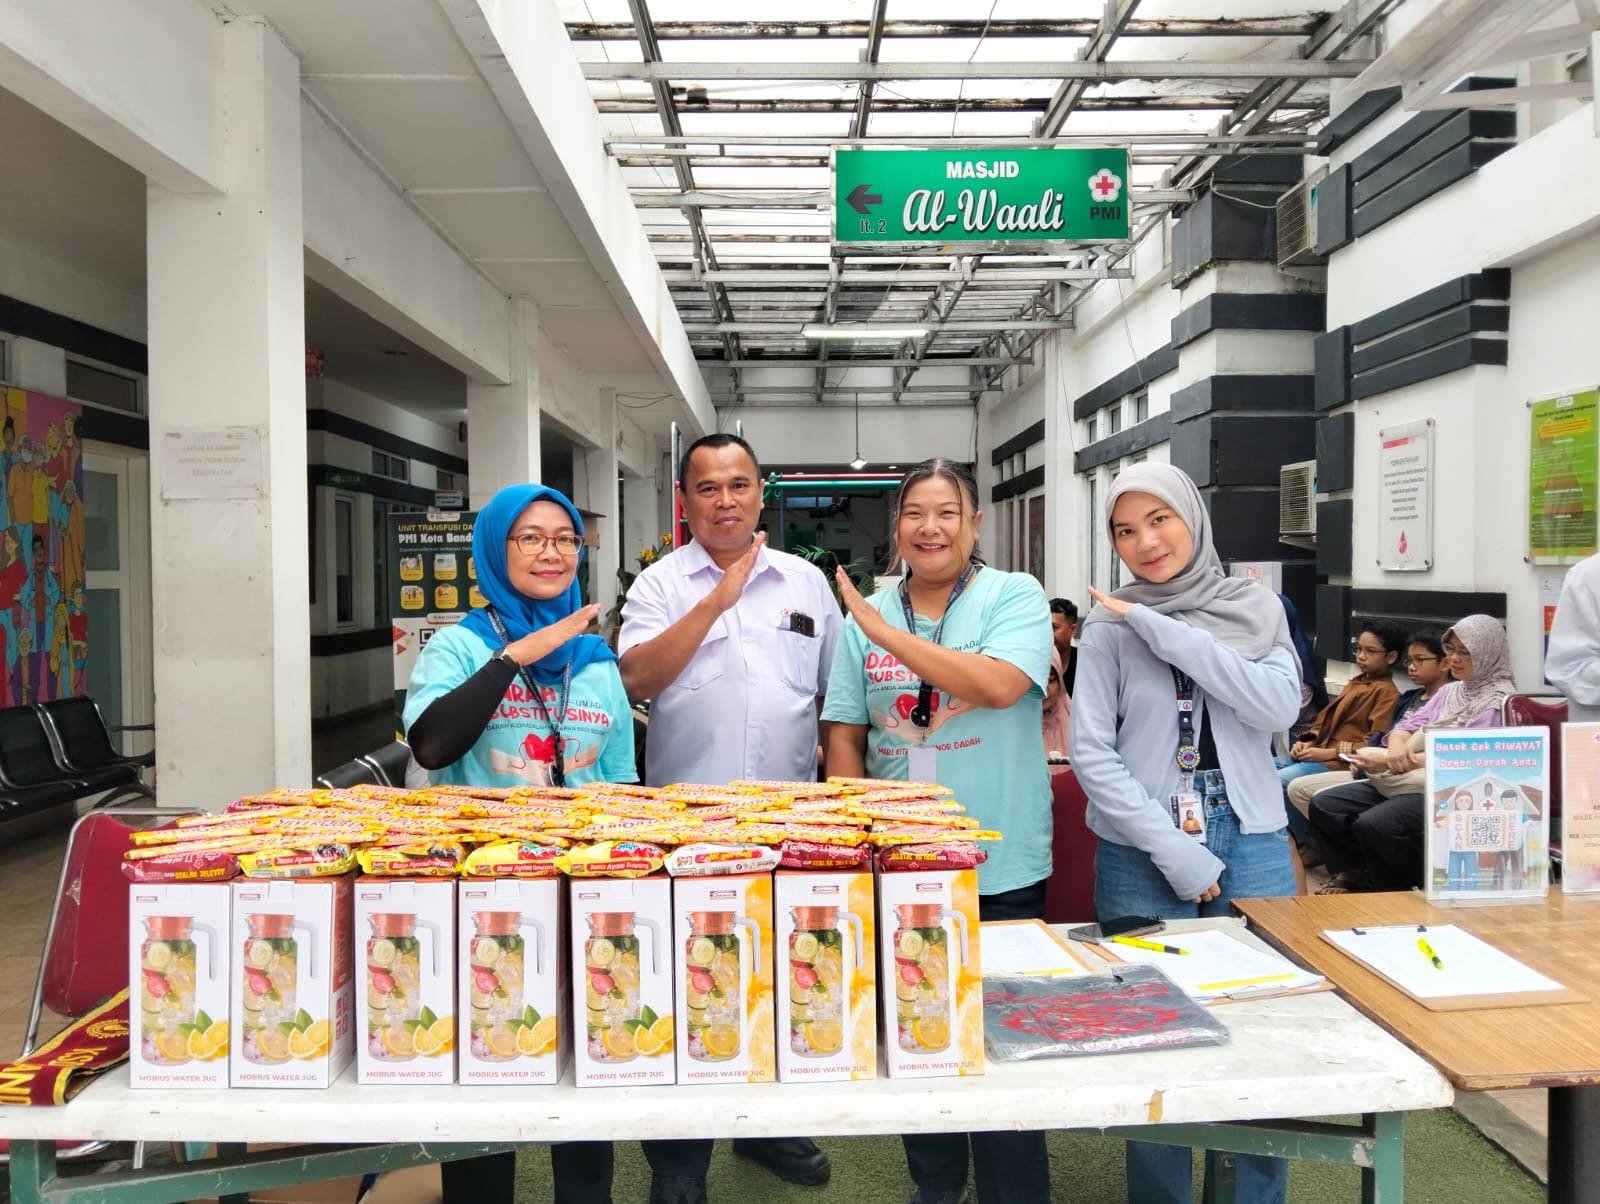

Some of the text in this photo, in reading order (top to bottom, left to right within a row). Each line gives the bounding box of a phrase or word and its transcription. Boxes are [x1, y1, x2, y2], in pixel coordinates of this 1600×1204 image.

[946, 161, 1019, 179] MASJID
[1089, 207, 1121, 220] PMI
[878, 219, 887, 233] 2
[398, 524, 416, 532] UNIT
[417, 524, 460, 532] TRANSFUSI
[398, 532, 474, 544] PMI Kota Band
[954, 737, 980, 749] DARAH
[1435, 741, 1541, 752] Untuk Cek RIWAYAT
[607, 863, 626, 871] Ayam
[899, 1063, 930, 1071] MOBIUS
[239, 1073, 270, 1081] MOBIUS
[720, 1070, 748, 1078] WATER
[749, 1069, 765, 1077] JUG
